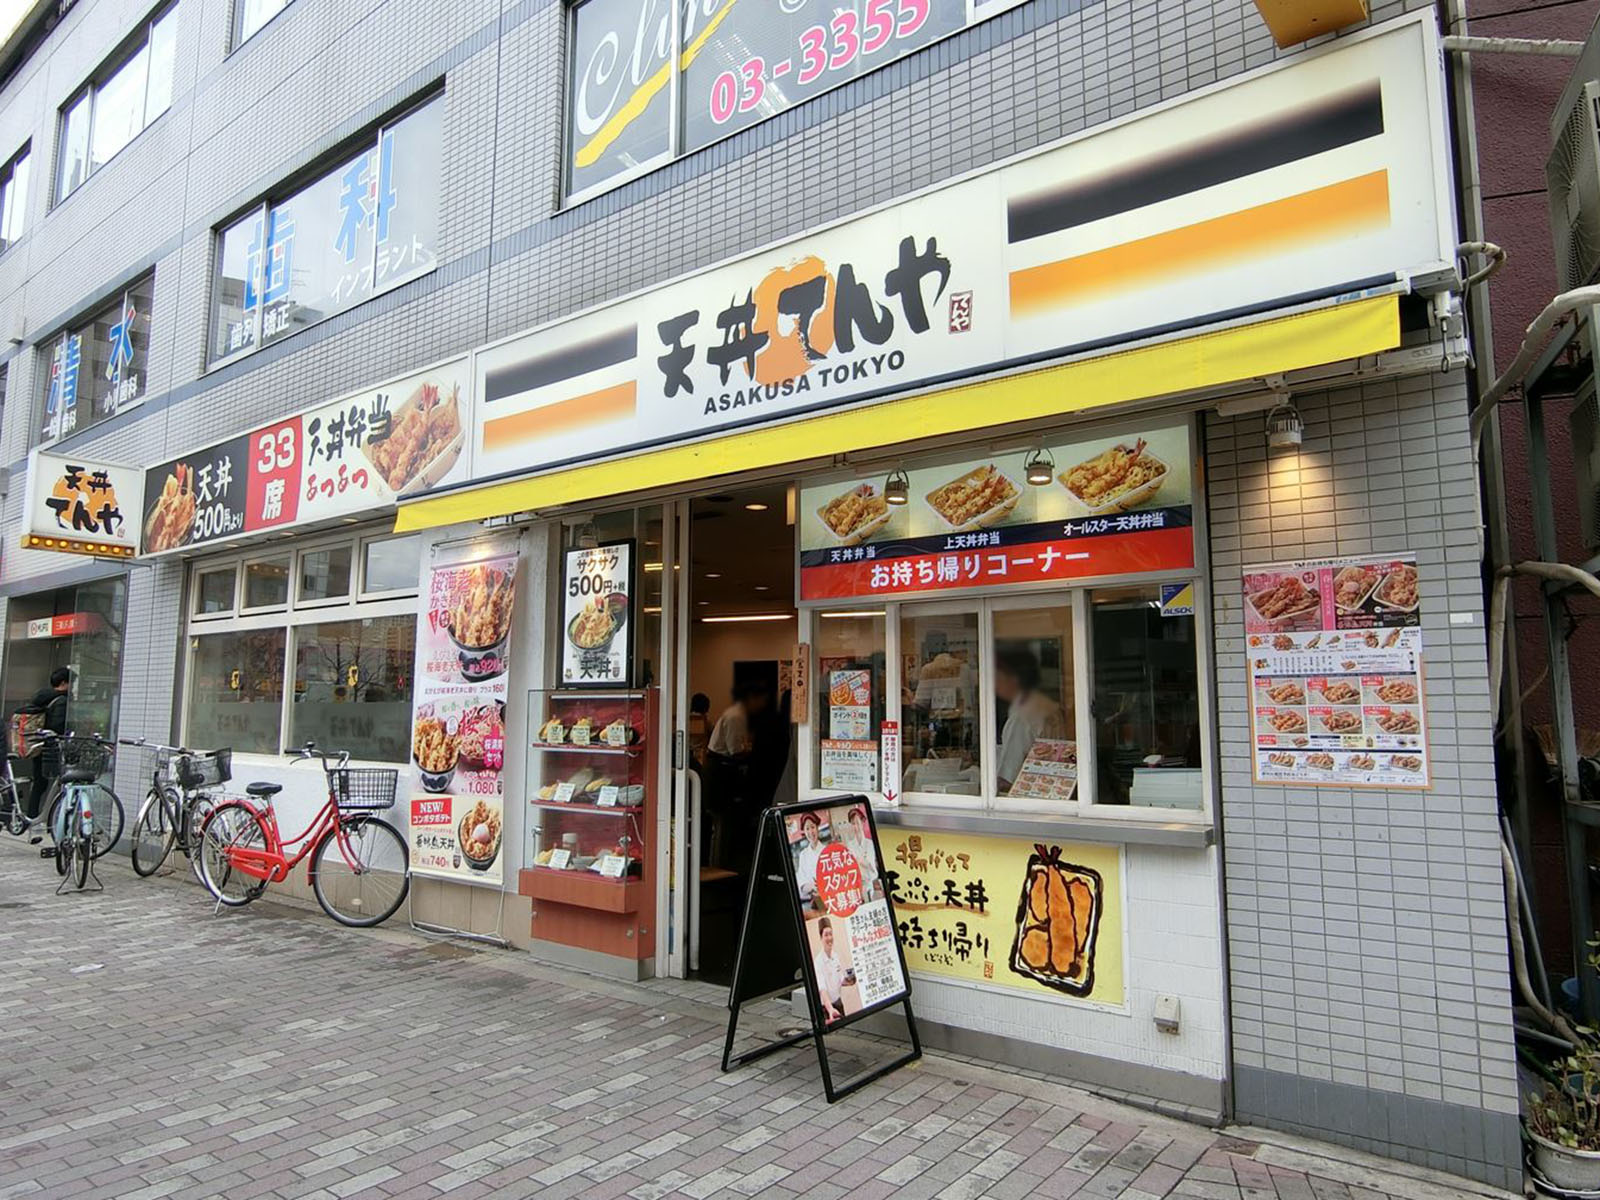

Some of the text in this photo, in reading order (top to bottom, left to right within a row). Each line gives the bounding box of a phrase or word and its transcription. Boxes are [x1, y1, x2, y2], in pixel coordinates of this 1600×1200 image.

[704, 350, 906, 415] ASAKUSA TOKYO
[307, 394, 392, 466] 天丼弁当
[257, 427, 296, 474] 33
[64, 464, 112, 494] 天丼
[196, 455, 233, 505] 天丼
[262, 479, 285, 521] 席
[45, 498, 123, 535] てんや
[1063, 512, 1164, 536] オールスター天丼弁当
[944, 530, 1000, 550] 上天丼弁当
[577, 555, 619, 574] サクサク
[830, 549, 876, 562] 天丼弁当
[870, 546, 1089, 588] お持ち帰りコーナー
[580, 658, 612, 680] 天丼
[420, 801, 444, 813] NEW!
[820, 849, 855, 873] 元気な
[823, 869, 859, 892] スタッフ
